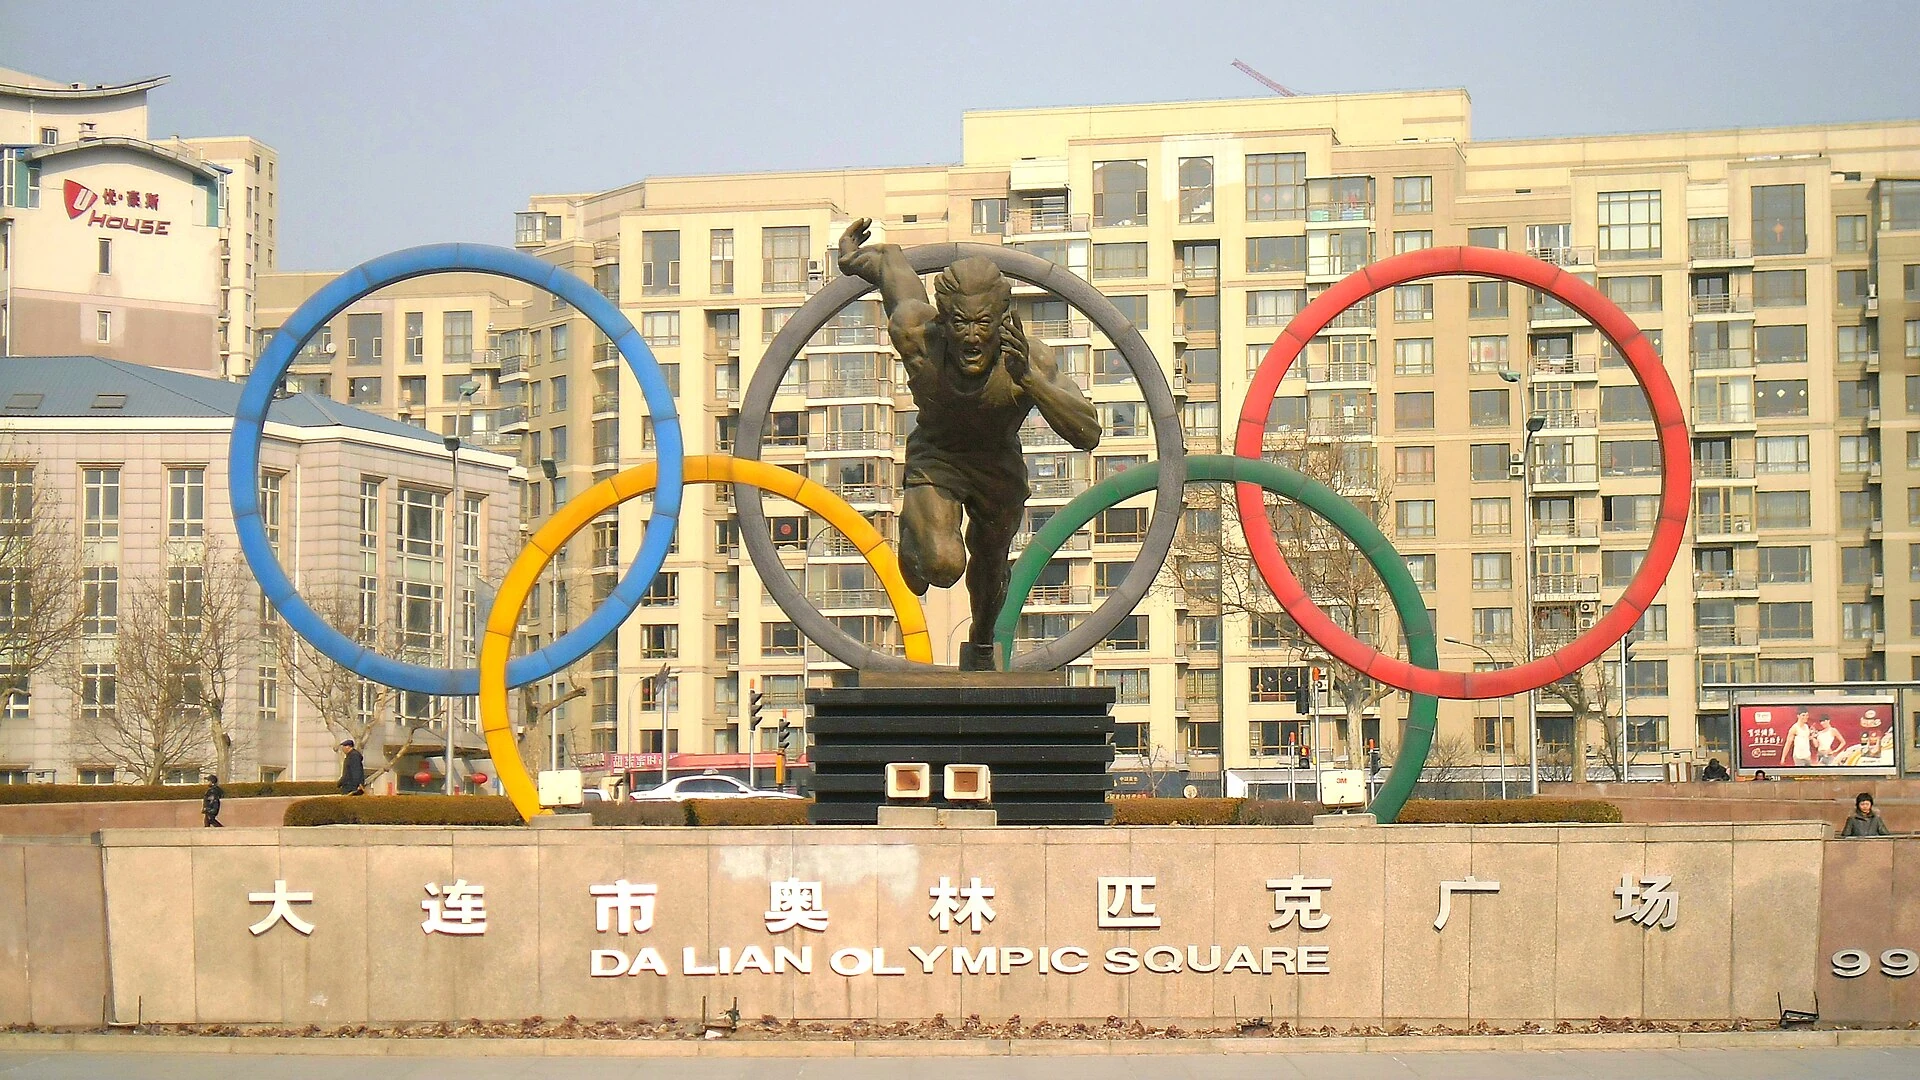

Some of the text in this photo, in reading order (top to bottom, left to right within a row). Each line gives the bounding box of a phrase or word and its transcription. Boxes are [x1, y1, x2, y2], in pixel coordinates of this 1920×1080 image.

[88, 210, 171, 235] HOUSE
[248, 873, 1680, 936] 大连市奥林匹克广场
[590, 945, 1330, 977] DA LIAN OLYMPIC SQUARE
